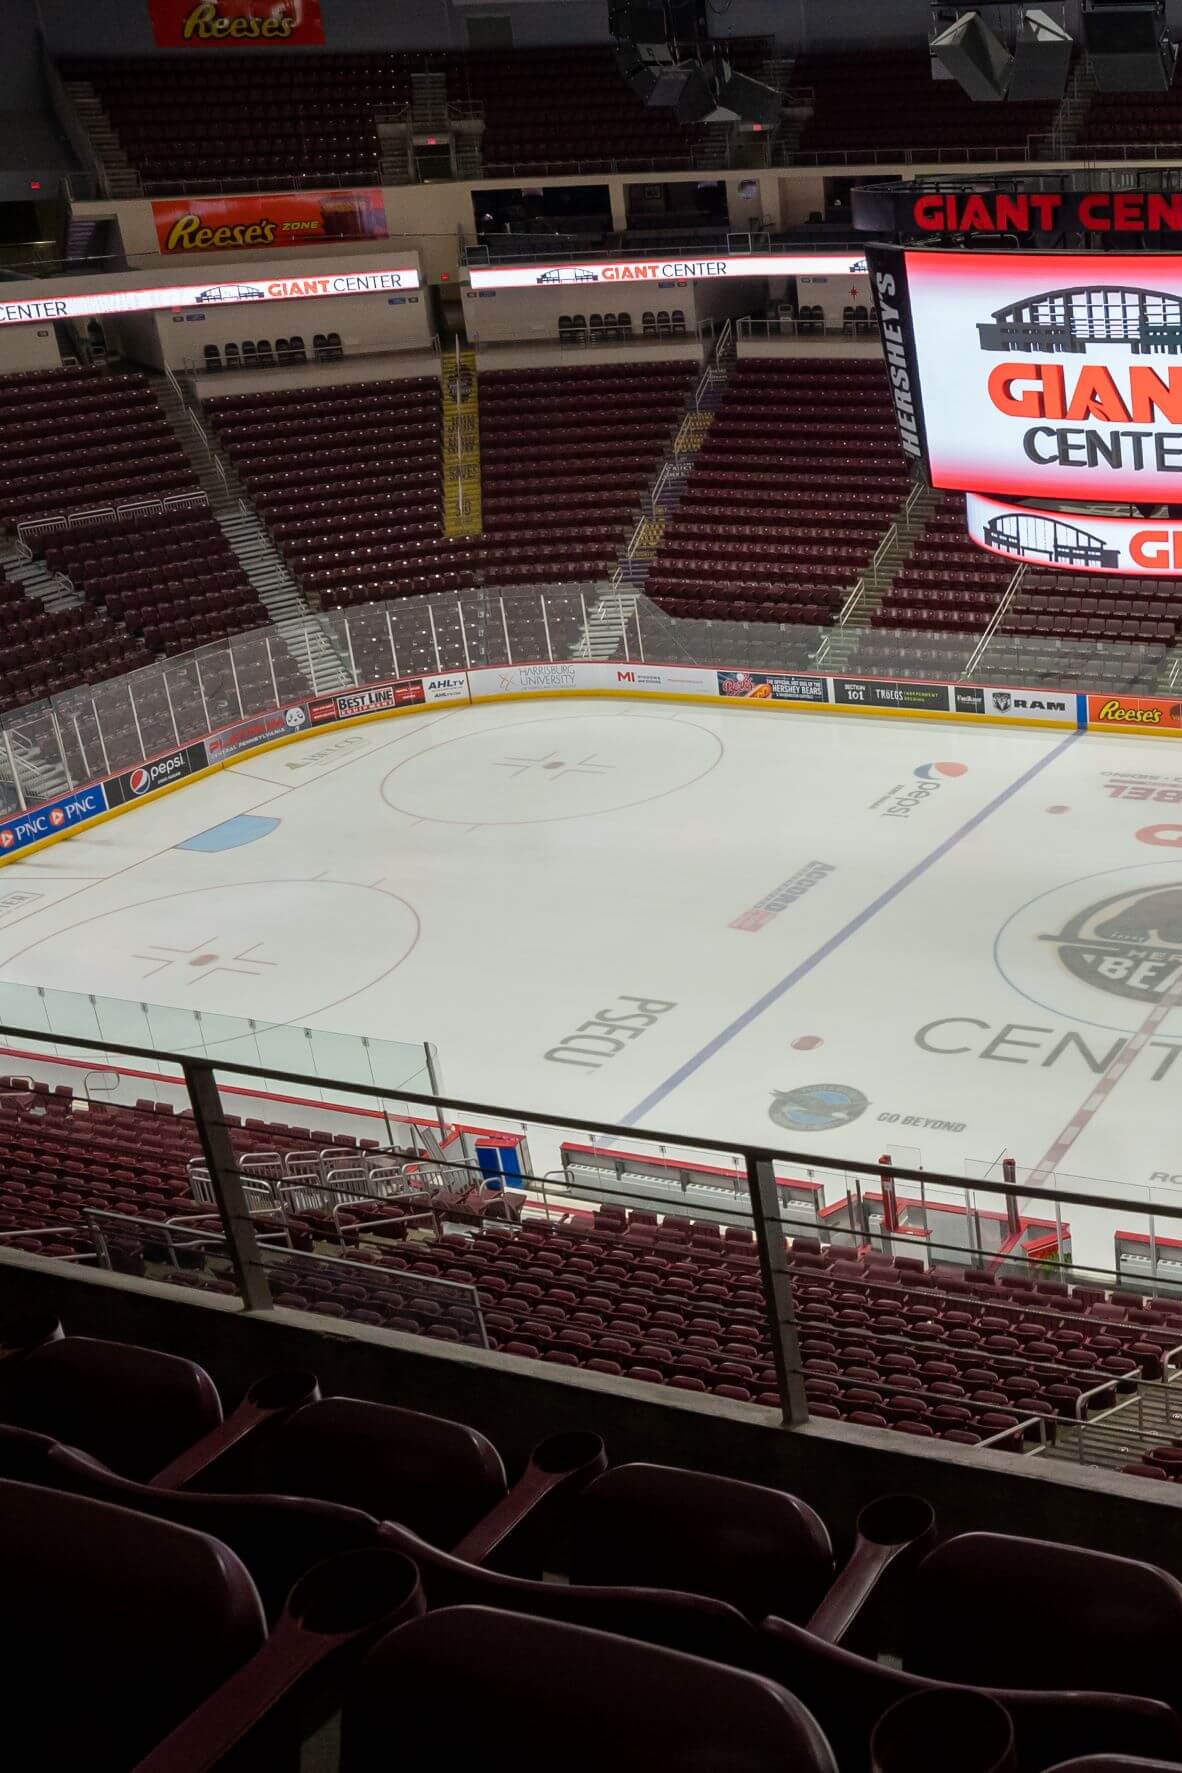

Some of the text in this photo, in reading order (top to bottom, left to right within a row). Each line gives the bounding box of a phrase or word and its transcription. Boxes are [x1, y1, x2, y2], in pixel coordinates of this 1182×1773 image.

[183, 4, 295, 39] Reese's
[913, 195, 1062, 231] GIANT
[166, 214, 320, 250] Reese's ZONE
[601, 262, 727, 280] GIANT CENTER
[268, 273, 402, 297] GIANT CENTER
[876, 271, 922, 457] HERSHEY'S
[520, 665, 575, 676] HARRISBURG
[520, 674, 576, 686] UNIVERSITY
[617, 671, 636, 683] MI
[339, 697, 366, 709] BEST
[368, 690, 393, 703] LINE
[773, 684, 800, 694] HERSHEY
[801, 686, 822, 696] BEARS
[848, 691, 865, 701] 101
[1013, 699, 1066, 712] RAM
[1099, 700, 1162, 723] Reese's
[150, 752, 185, 781] pepsi
[64, 795, 96, 819] PNC
[881, 780, 941, 818] pepsi
[15, 816, 49, 842] PNC
[764, 861, 837, 912] ACCORD
[544, 995, 678, 1068] PSECU
[877, 1111, 967, 1133] GO BEYOND
